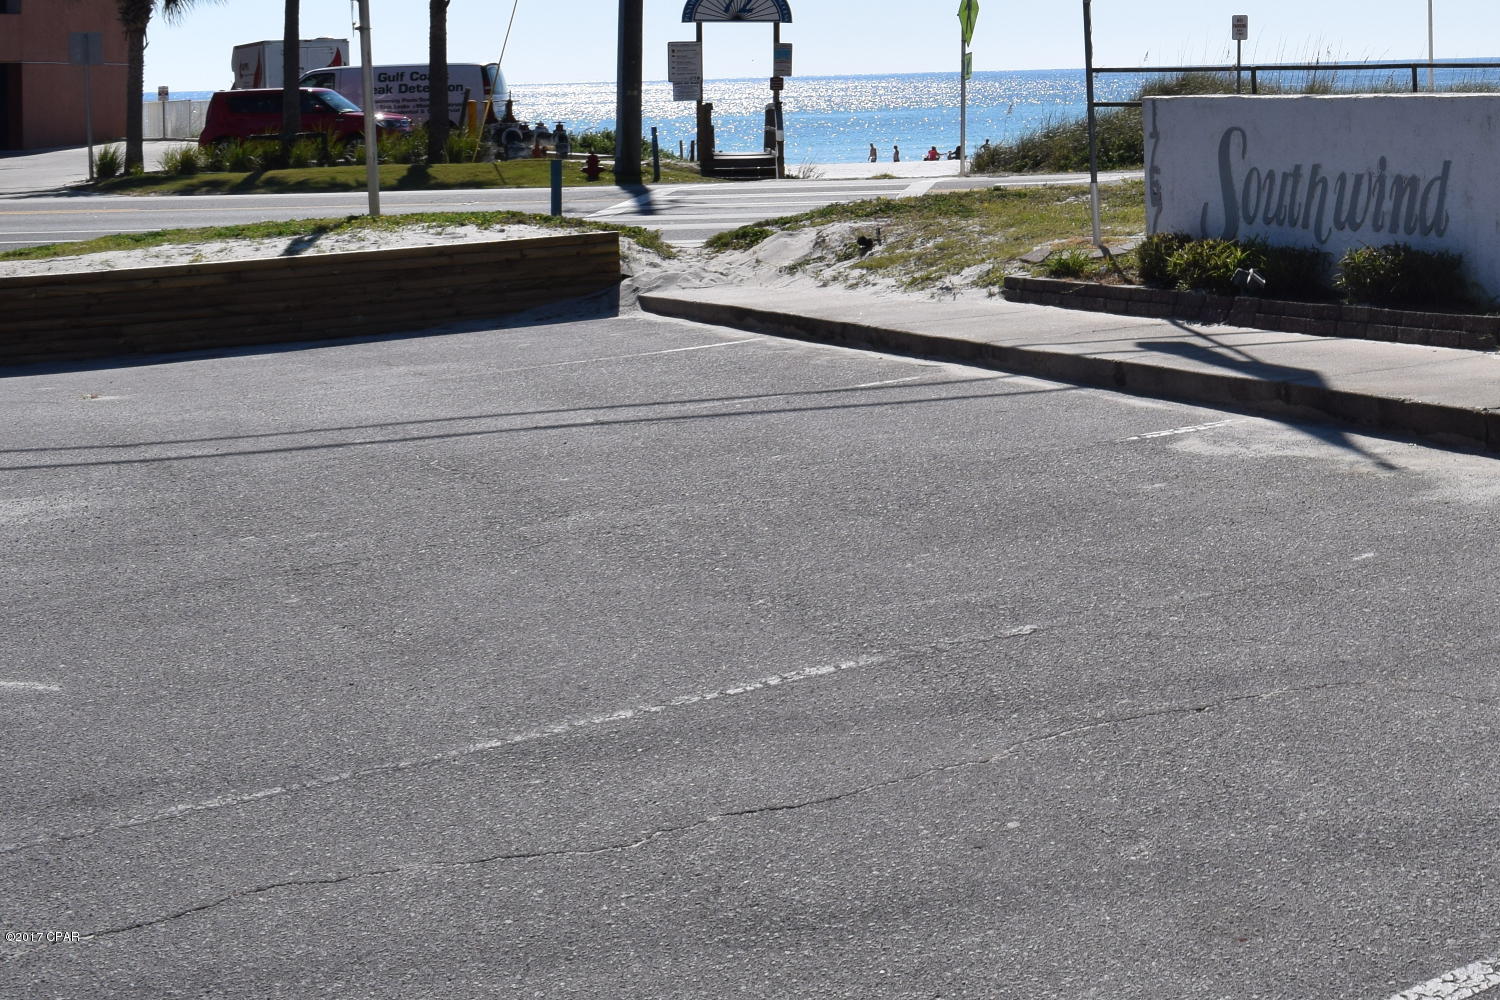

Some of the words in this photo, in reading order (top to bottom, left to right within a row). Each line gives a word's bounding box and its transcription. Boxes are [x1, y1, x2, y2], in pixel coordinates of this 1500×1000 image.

[378, 72, 405, 82] Gulf
[373, 85, 392, 95] eak
[398, 83, 463, 94] Deteon
[1200, 126, 1451, 245] Southwind
